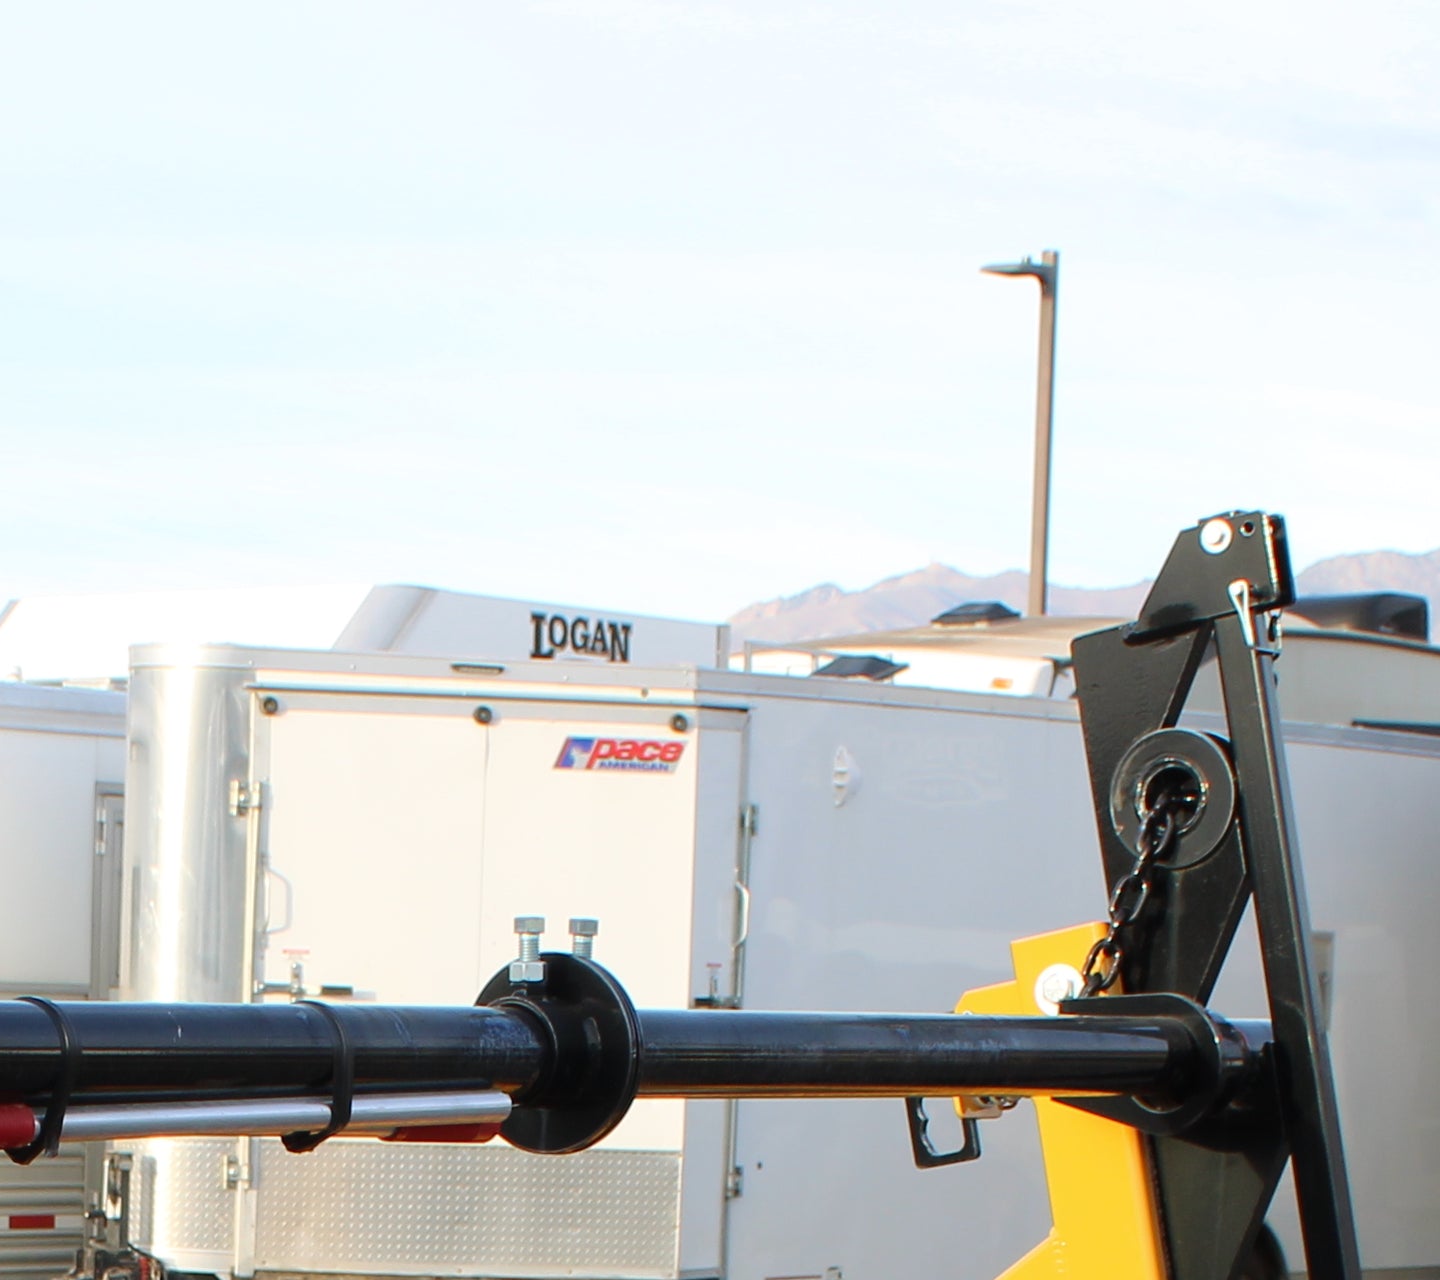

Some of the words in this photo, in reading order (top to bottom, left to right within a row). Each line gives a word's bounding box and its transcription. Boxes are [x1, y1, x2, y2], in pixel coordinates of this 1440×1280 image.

[531, 611, 633, 663] LOGAN
[585, 739, 686, 769] pace
[599, 760, 670, 772] AMERICAN
